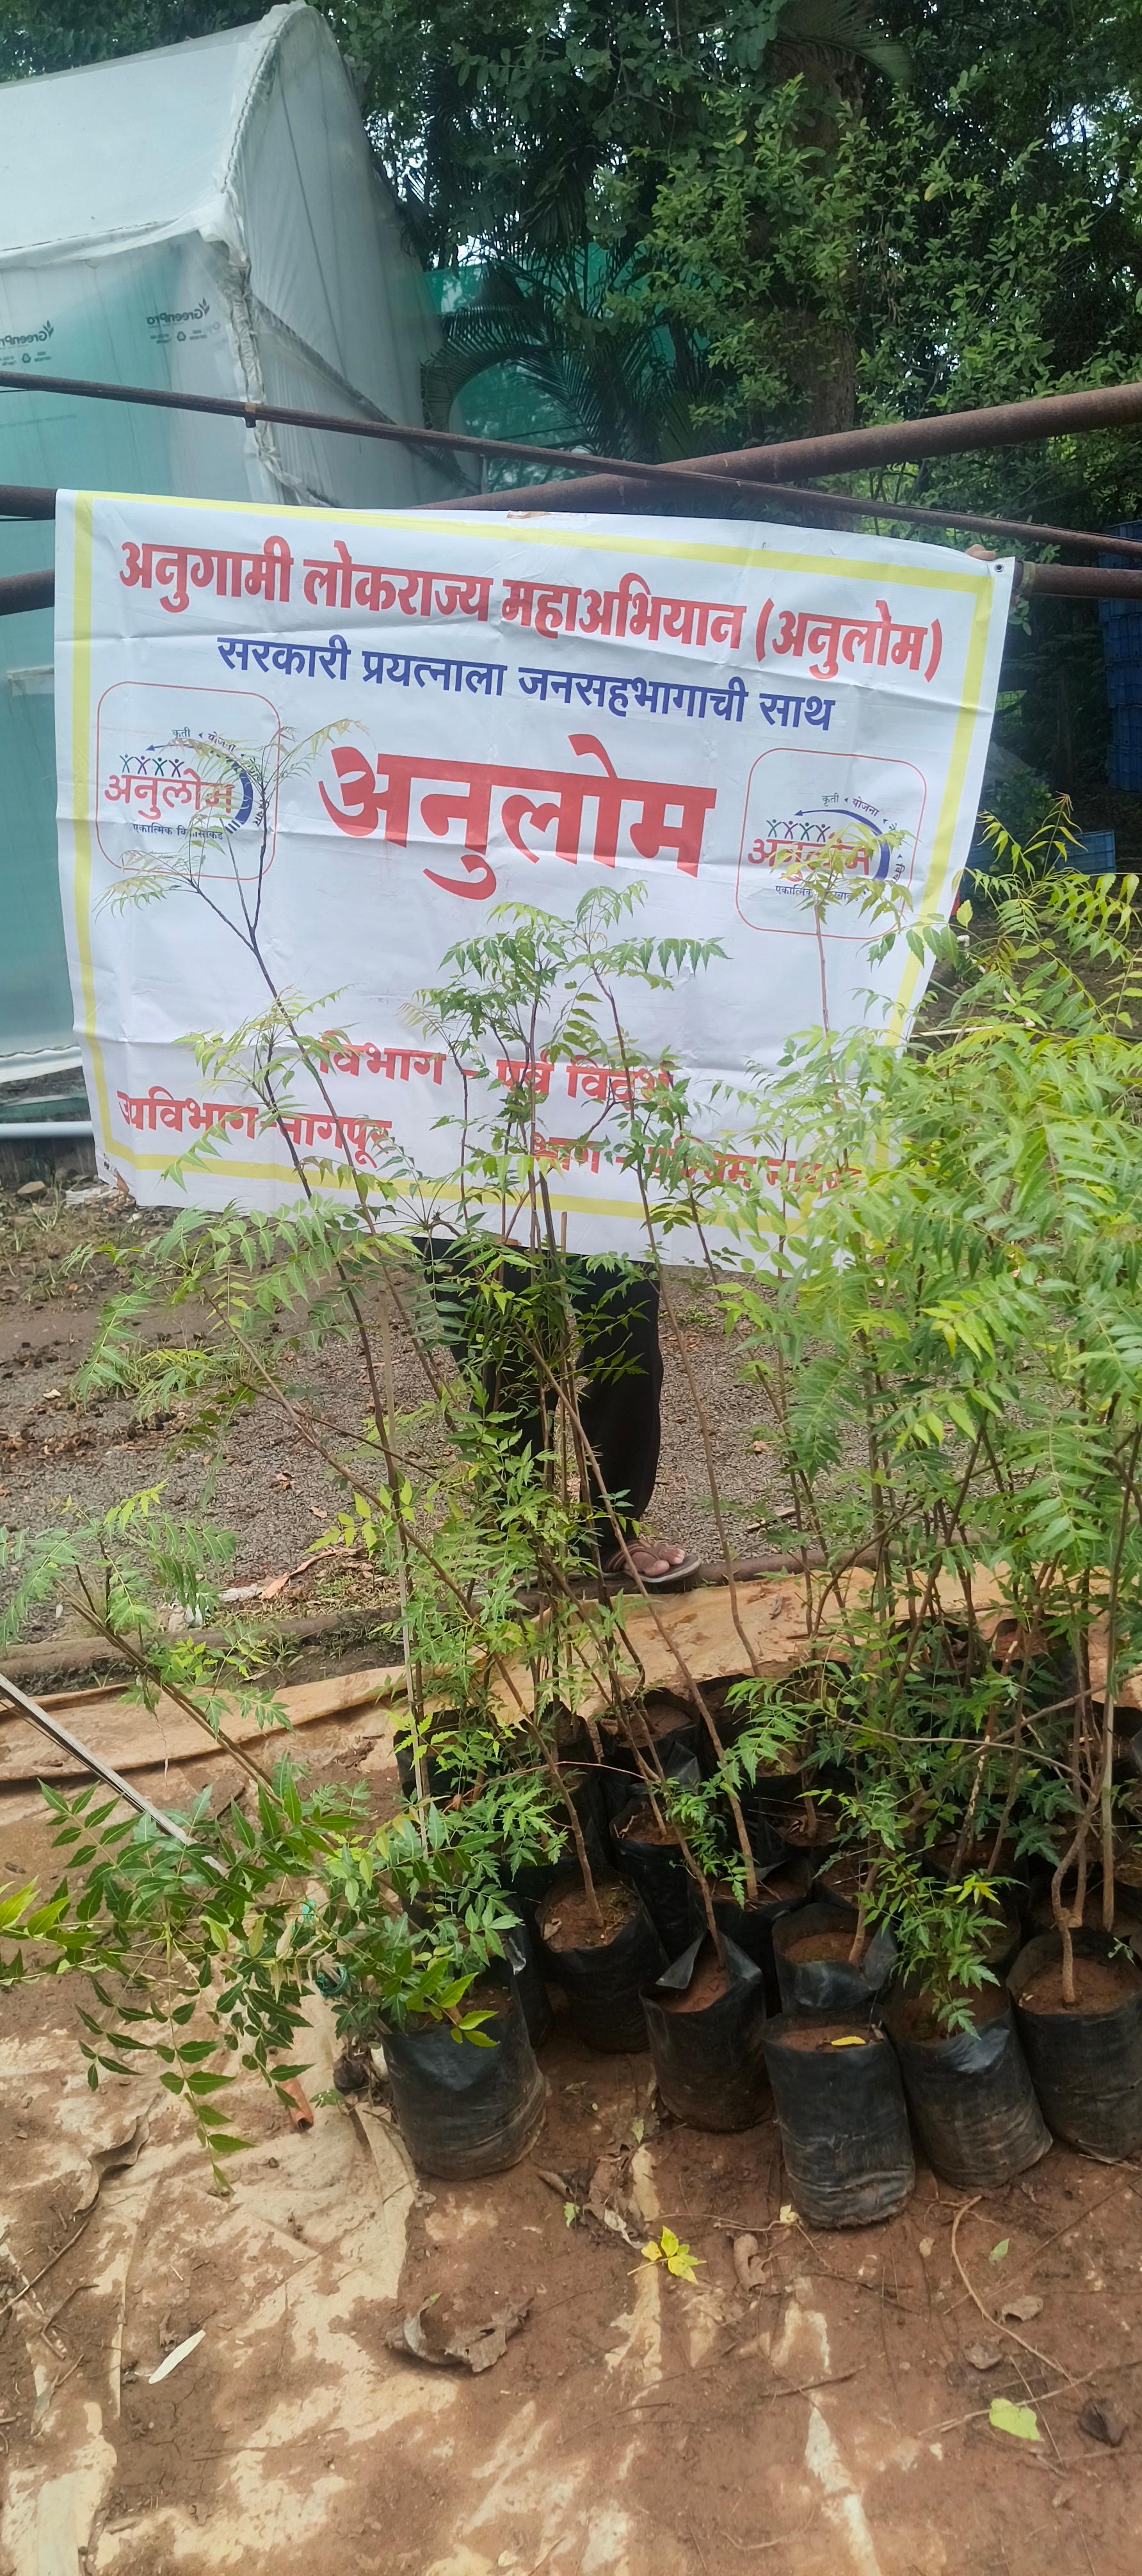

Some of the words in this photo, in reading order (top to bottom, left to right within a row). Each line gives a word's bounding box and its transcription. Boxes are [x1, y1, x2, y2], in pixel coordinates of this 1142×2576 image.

[119, 535, 294, 613] अनुगामी
[303, 540, 494, 622] लोकराज्य
[501, 572, 746, 650] महाअभियान
[755, 598, 943, 683] (अनुलोम)
[216, 634, 351, 680] सरकारी
[362, 650, 509, 696] प्रयत्नाला
[518, 666, 749, 722] जनसहभागाची
[759, 693, 836, 731] साथ
[318, 734, 718, 901] अनुलोम
[821, 793, 839, 807] कृती
[852, 796, 880, 817] योजना
